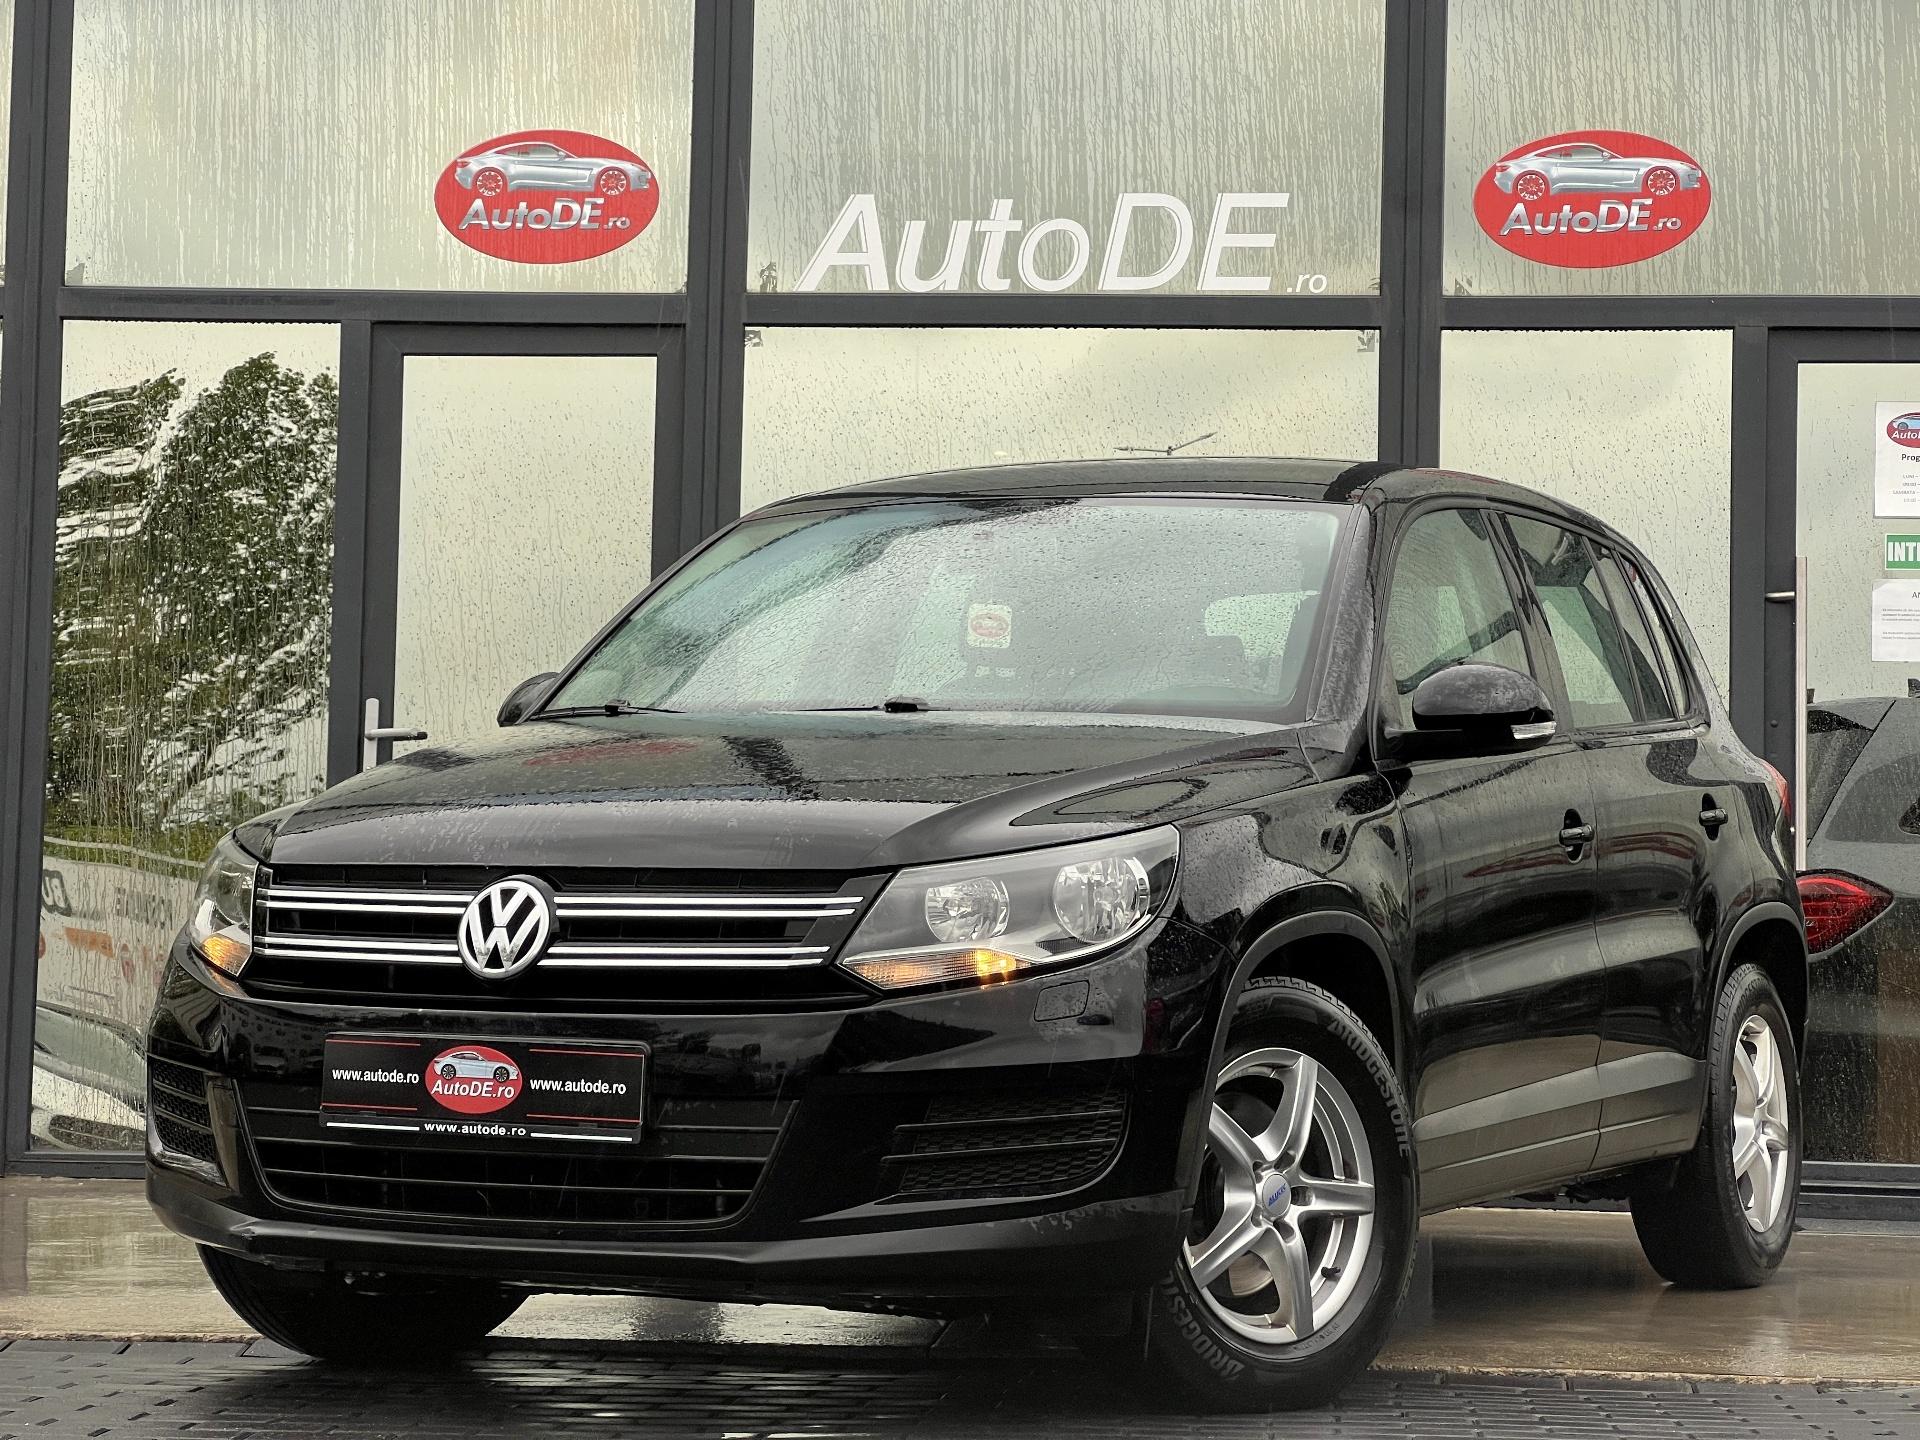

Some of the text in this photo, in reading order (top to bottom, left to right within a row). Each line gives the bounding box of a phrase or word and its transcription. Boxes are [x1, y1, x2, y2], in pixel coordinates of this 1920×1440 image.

[331, 1066, 420, 1085] www.autode.ro
[430, 1078, 516, 1100] AutoDE.ro
[529, 1077, 627, 1096] www.autode.ro
[1326, 1018, 1412, 1158] BRIDGESTONE
[423, 1121, 527, 1137] www.autode.ro
